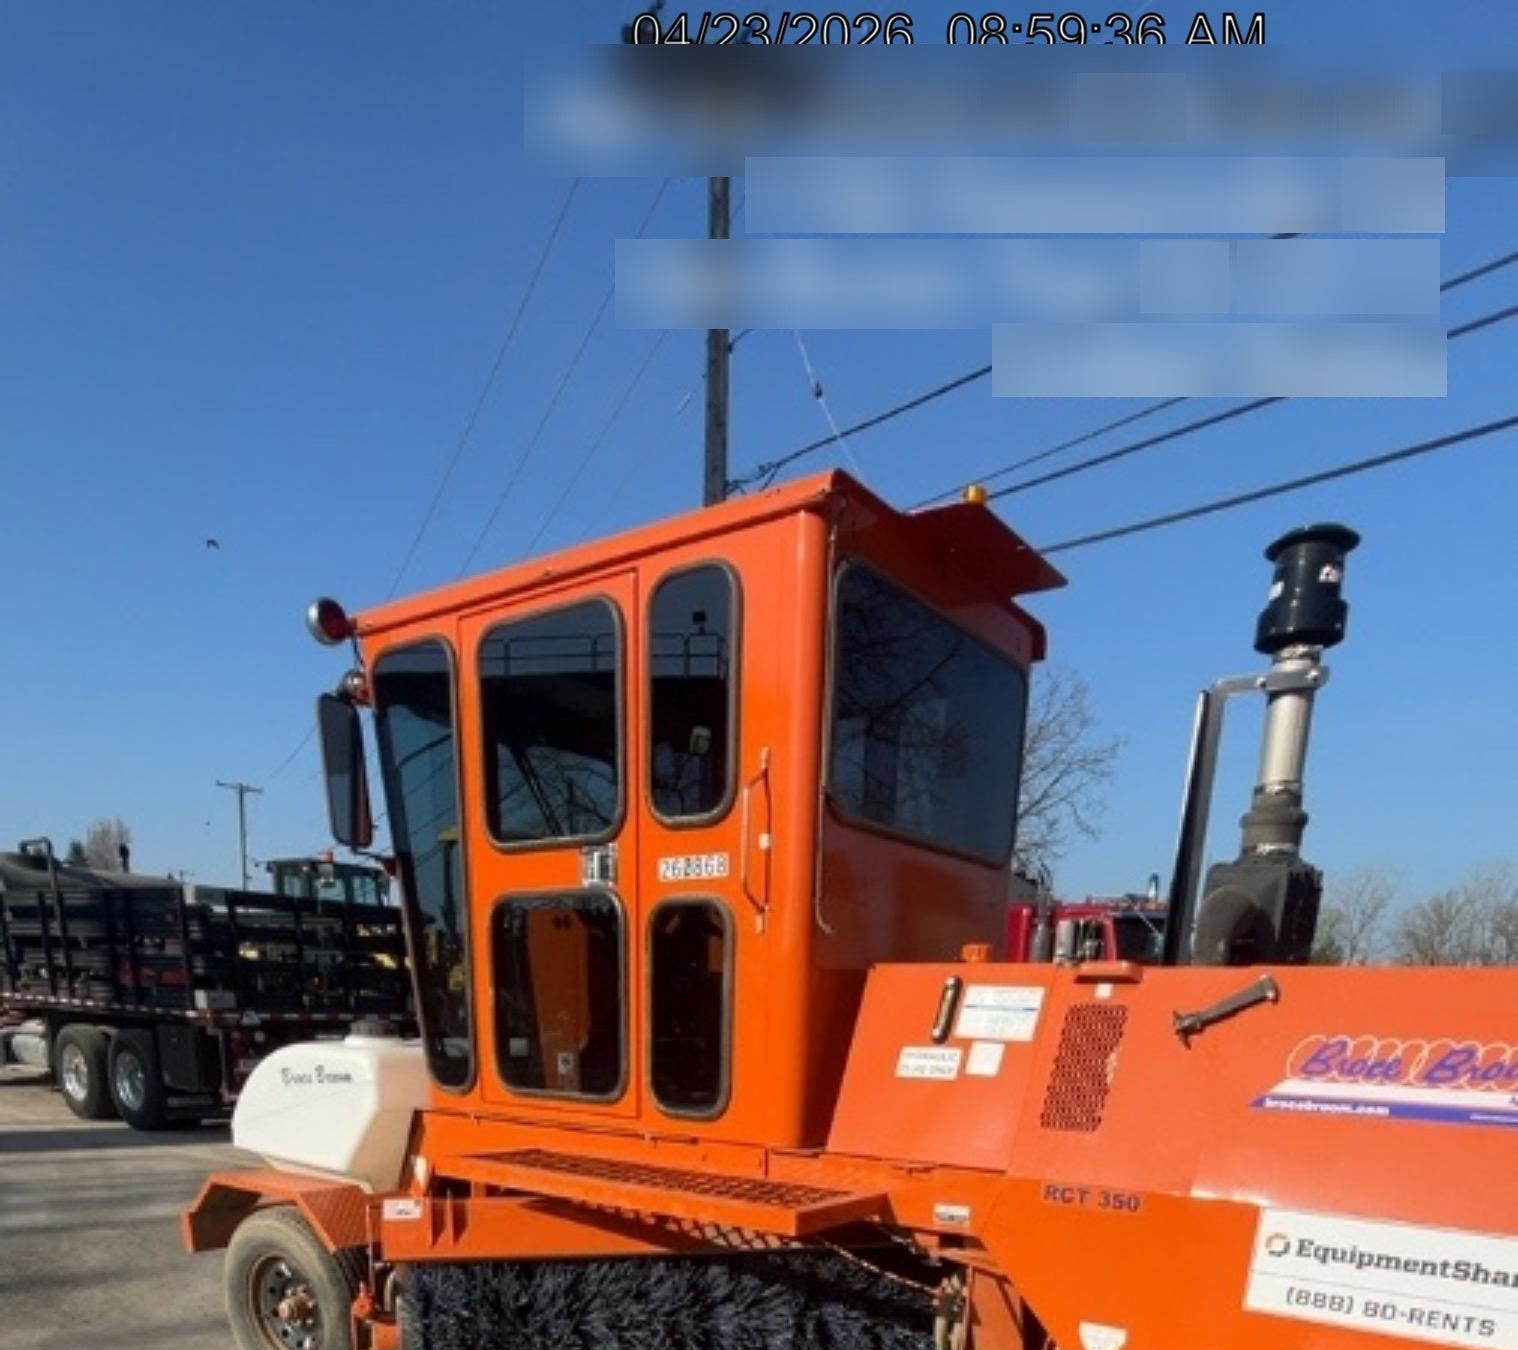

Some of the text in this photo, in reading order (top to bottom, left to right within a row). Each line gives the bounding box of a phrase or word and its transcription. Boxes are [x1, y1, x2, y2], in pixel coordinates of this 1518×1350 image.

[1299, 1037, 1403, 1080] Broce
[1044, 1184, 1140, 1213] RCT 350
[1286, 1286, 1496, 1337] (888) 80-RENTS
